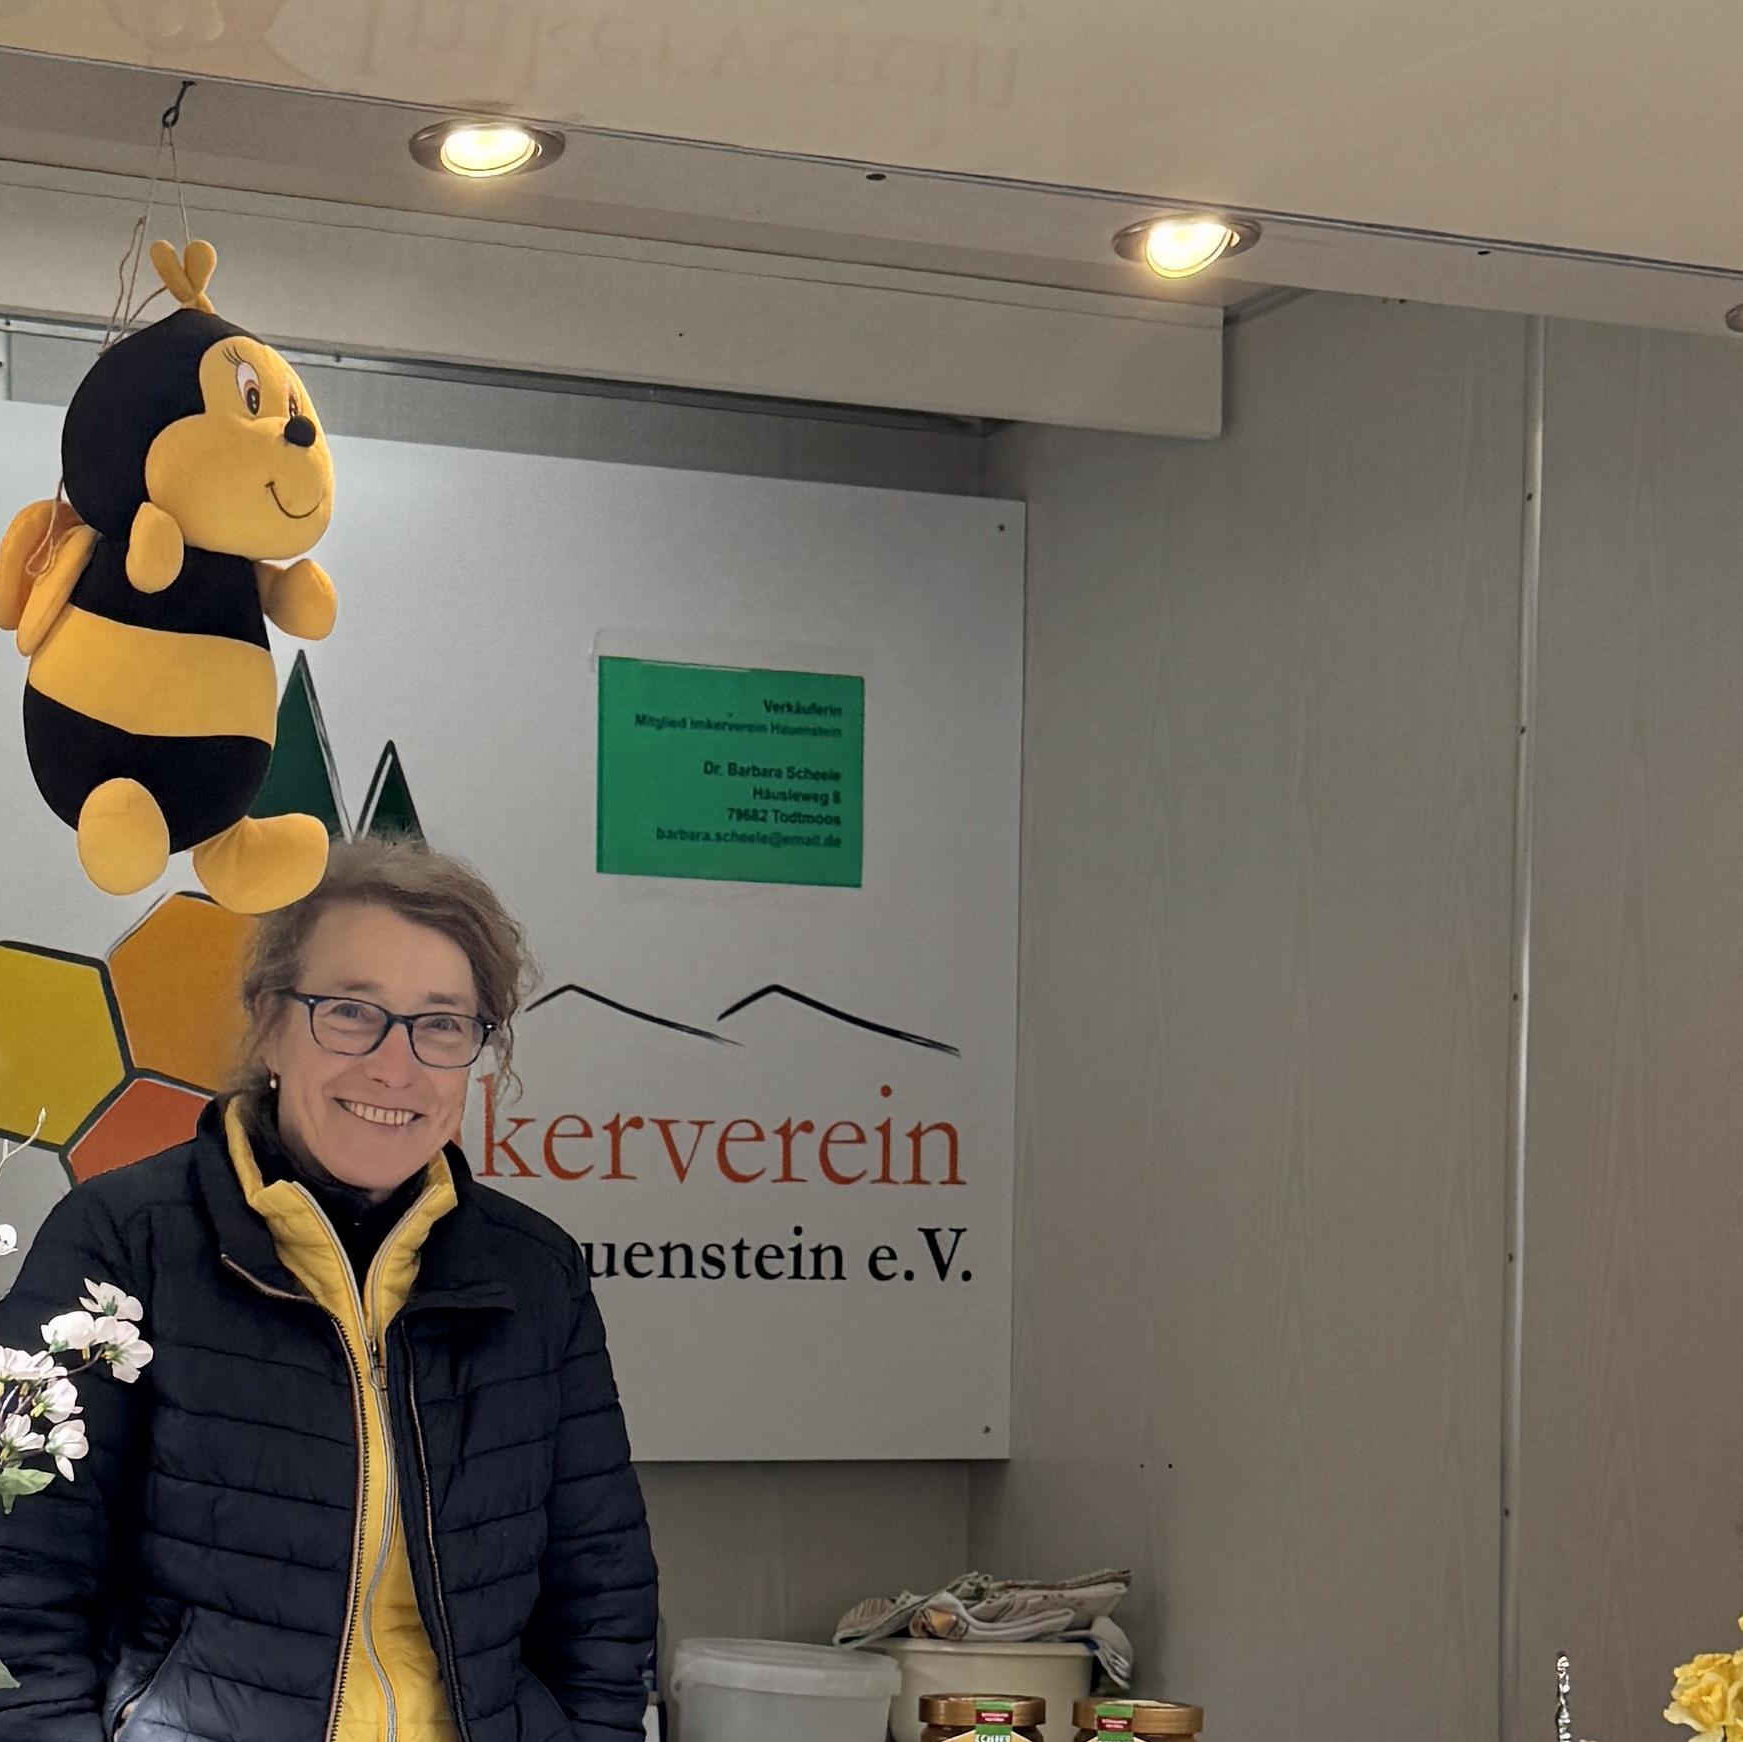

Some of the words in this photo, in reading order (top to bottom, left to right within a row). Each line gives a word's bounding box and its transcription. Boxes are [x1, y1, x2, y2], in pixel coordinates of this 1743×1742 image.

[635, 713, 687, 730] Mitglied
[703, 761, 722, 776] Dr.
[728, 762, 783, 779] Barbara
[772, 809, 841, 826] Todtmoos
[475, 1072, 969, 1186] kerverein
[580, 1225, 848, 1282] uenstein
[867, 1227, 974, 1283] e.V.
